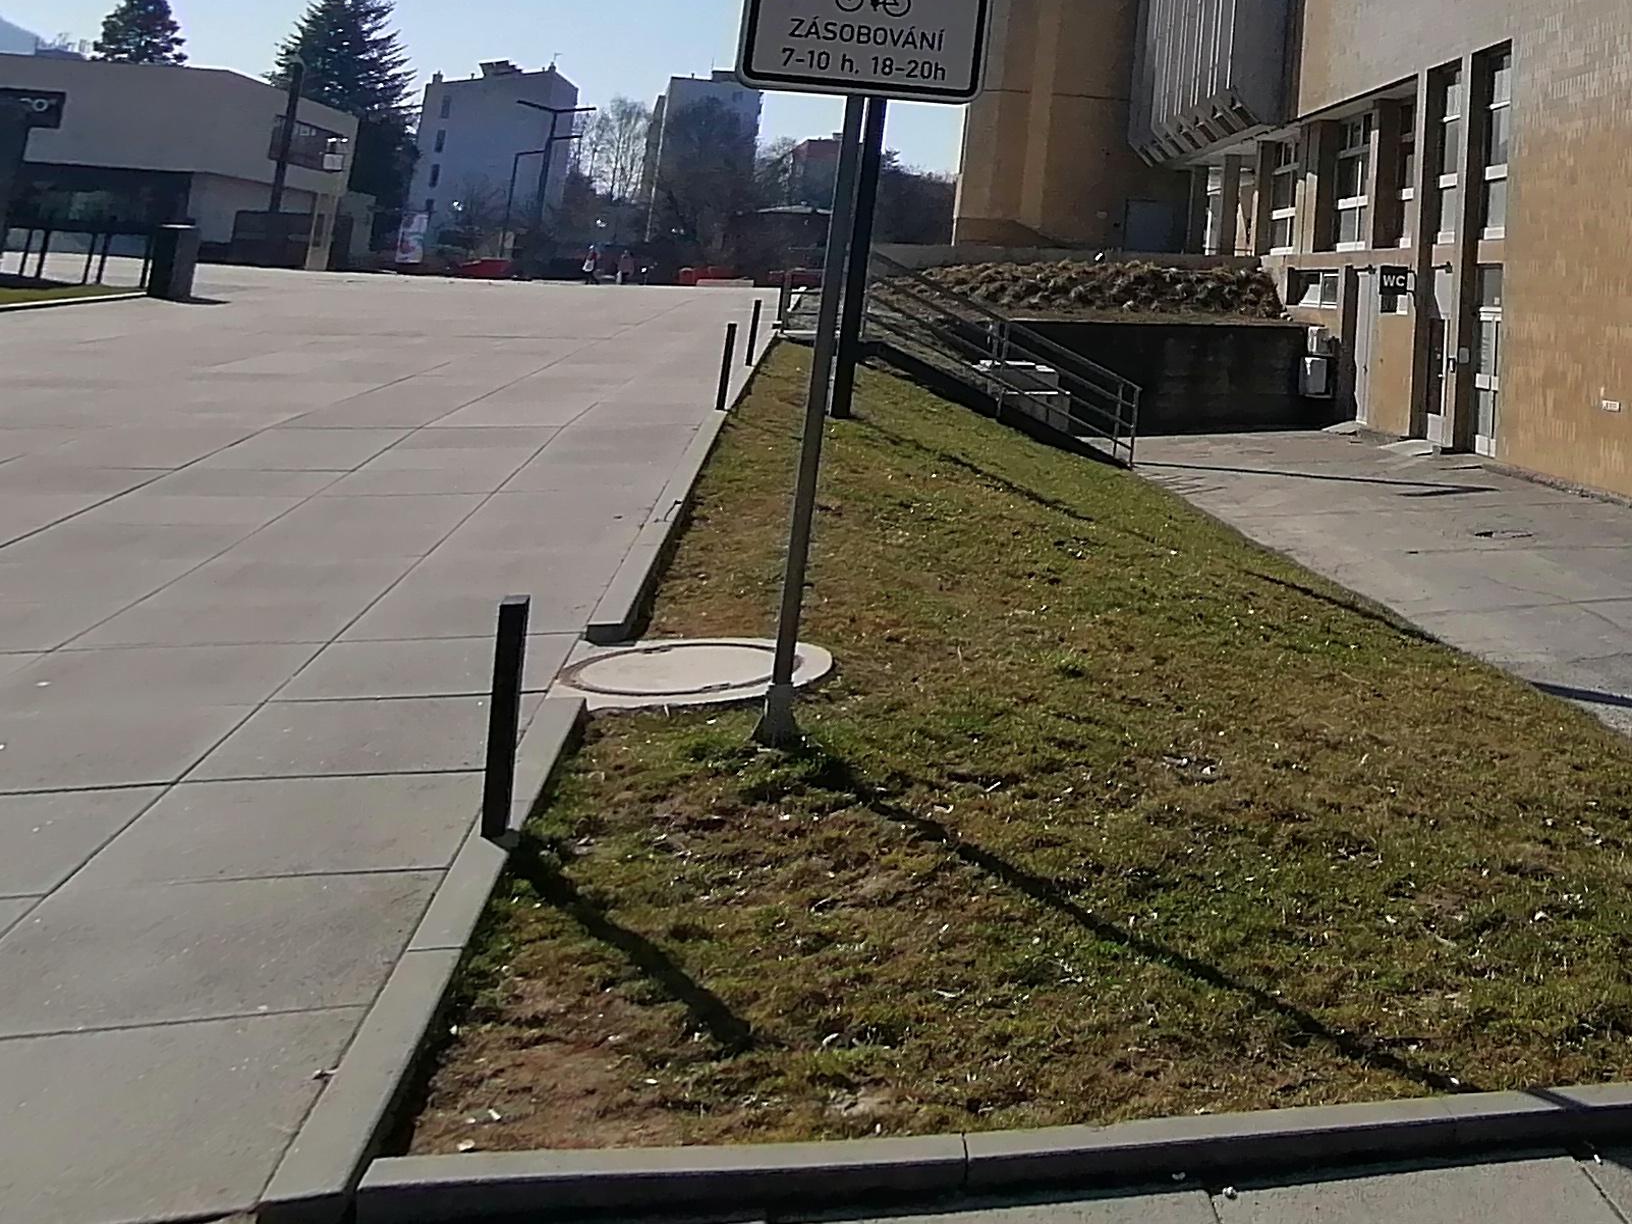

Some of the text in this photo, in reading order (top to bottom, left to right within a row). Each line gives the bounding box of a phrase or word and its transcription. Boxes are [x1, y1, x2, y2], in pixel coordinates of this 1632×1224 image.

[788, 16, 945, 52] ZÁSOBOVÁNÍ
[782, 47, 830, 71] 7-10
[872, 56, 946, 81] 18-20h
[1383, 274, 1406, 287] WC
